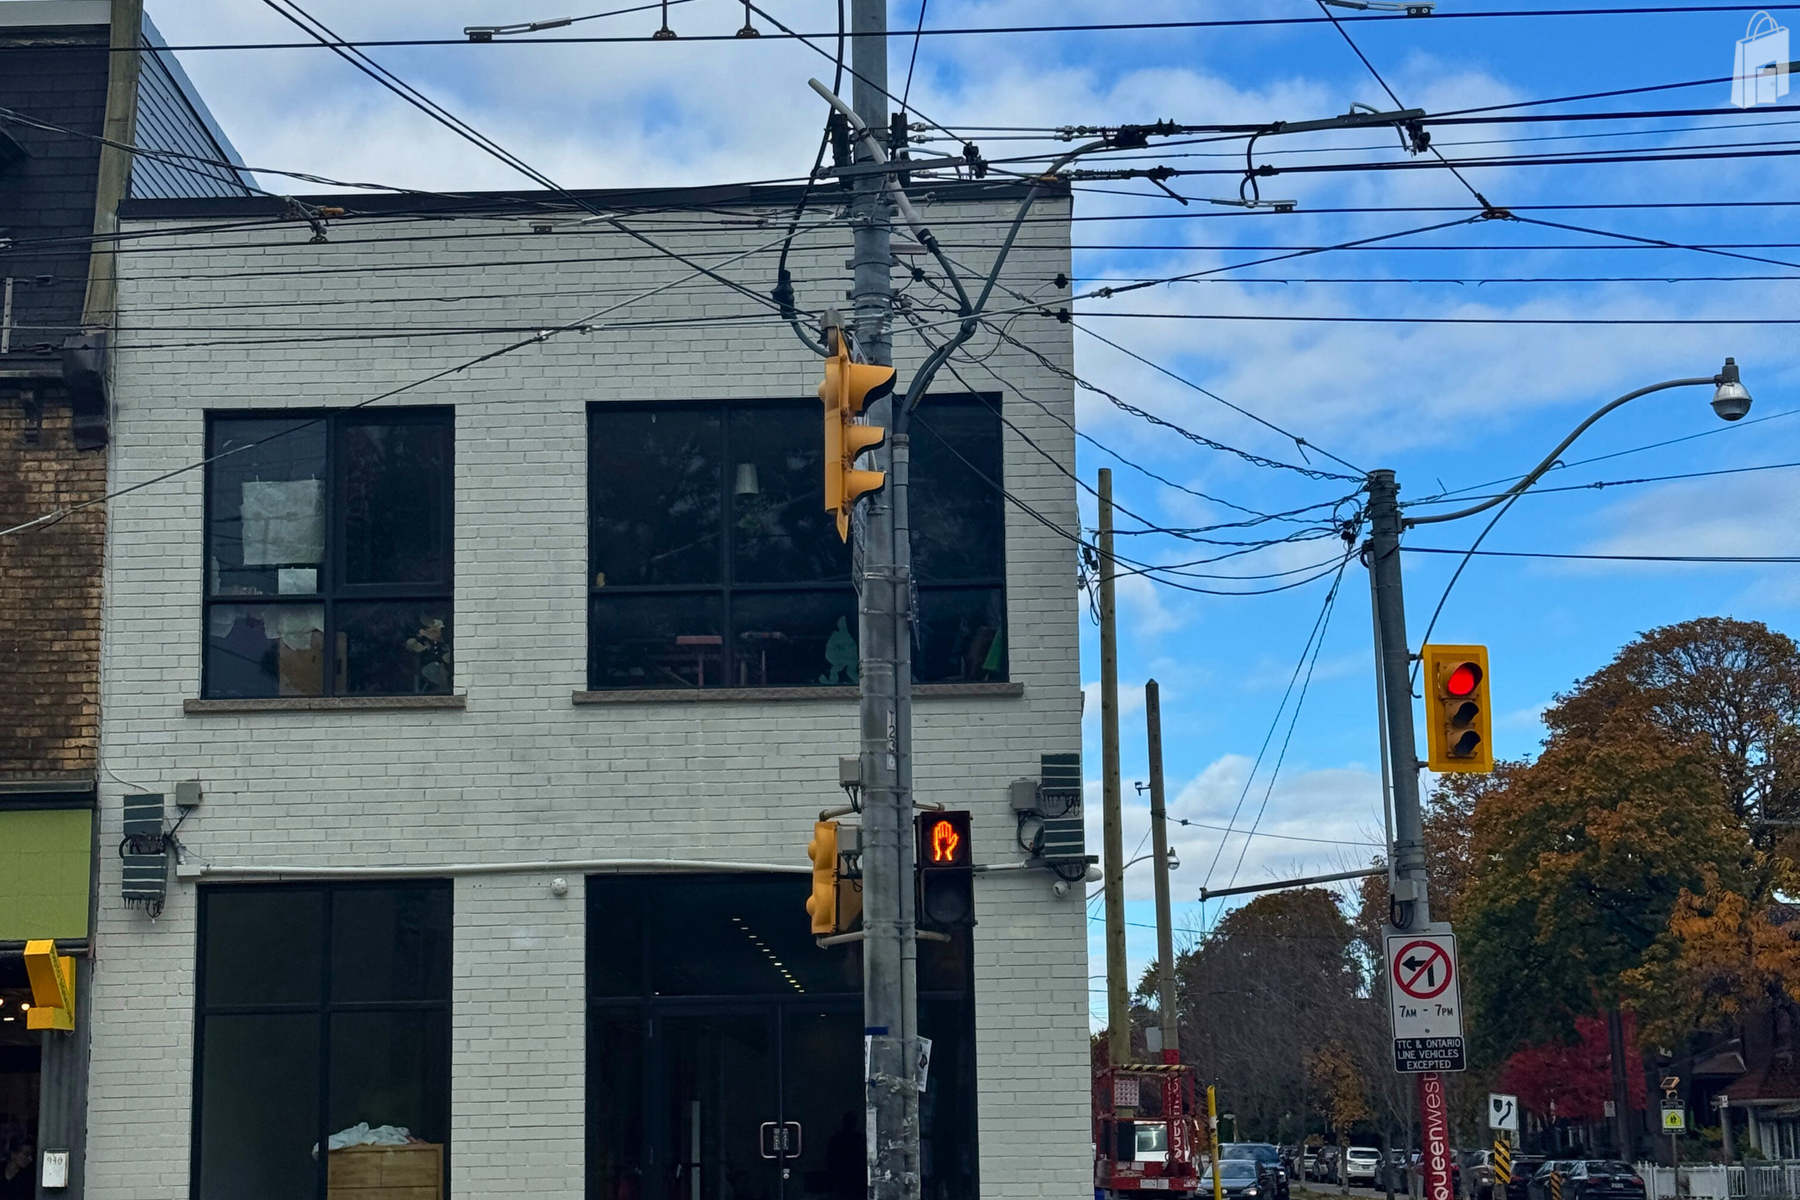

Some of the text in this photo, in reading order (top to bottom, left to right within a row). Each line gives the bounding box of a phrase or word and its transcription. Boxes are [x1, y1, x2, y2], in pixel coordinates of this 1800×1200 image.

[1399, 1005, 1417, 1018] 7AM
[1434, 1004, 1454, 1017] 7PM
[1397, 1038, 1461, 1049] TTC & ONTARIO
[1397, 1049, 1459, 1060] LINE VEHICLES
[1406, 1060, 1451, 1070] EXCEPTED
